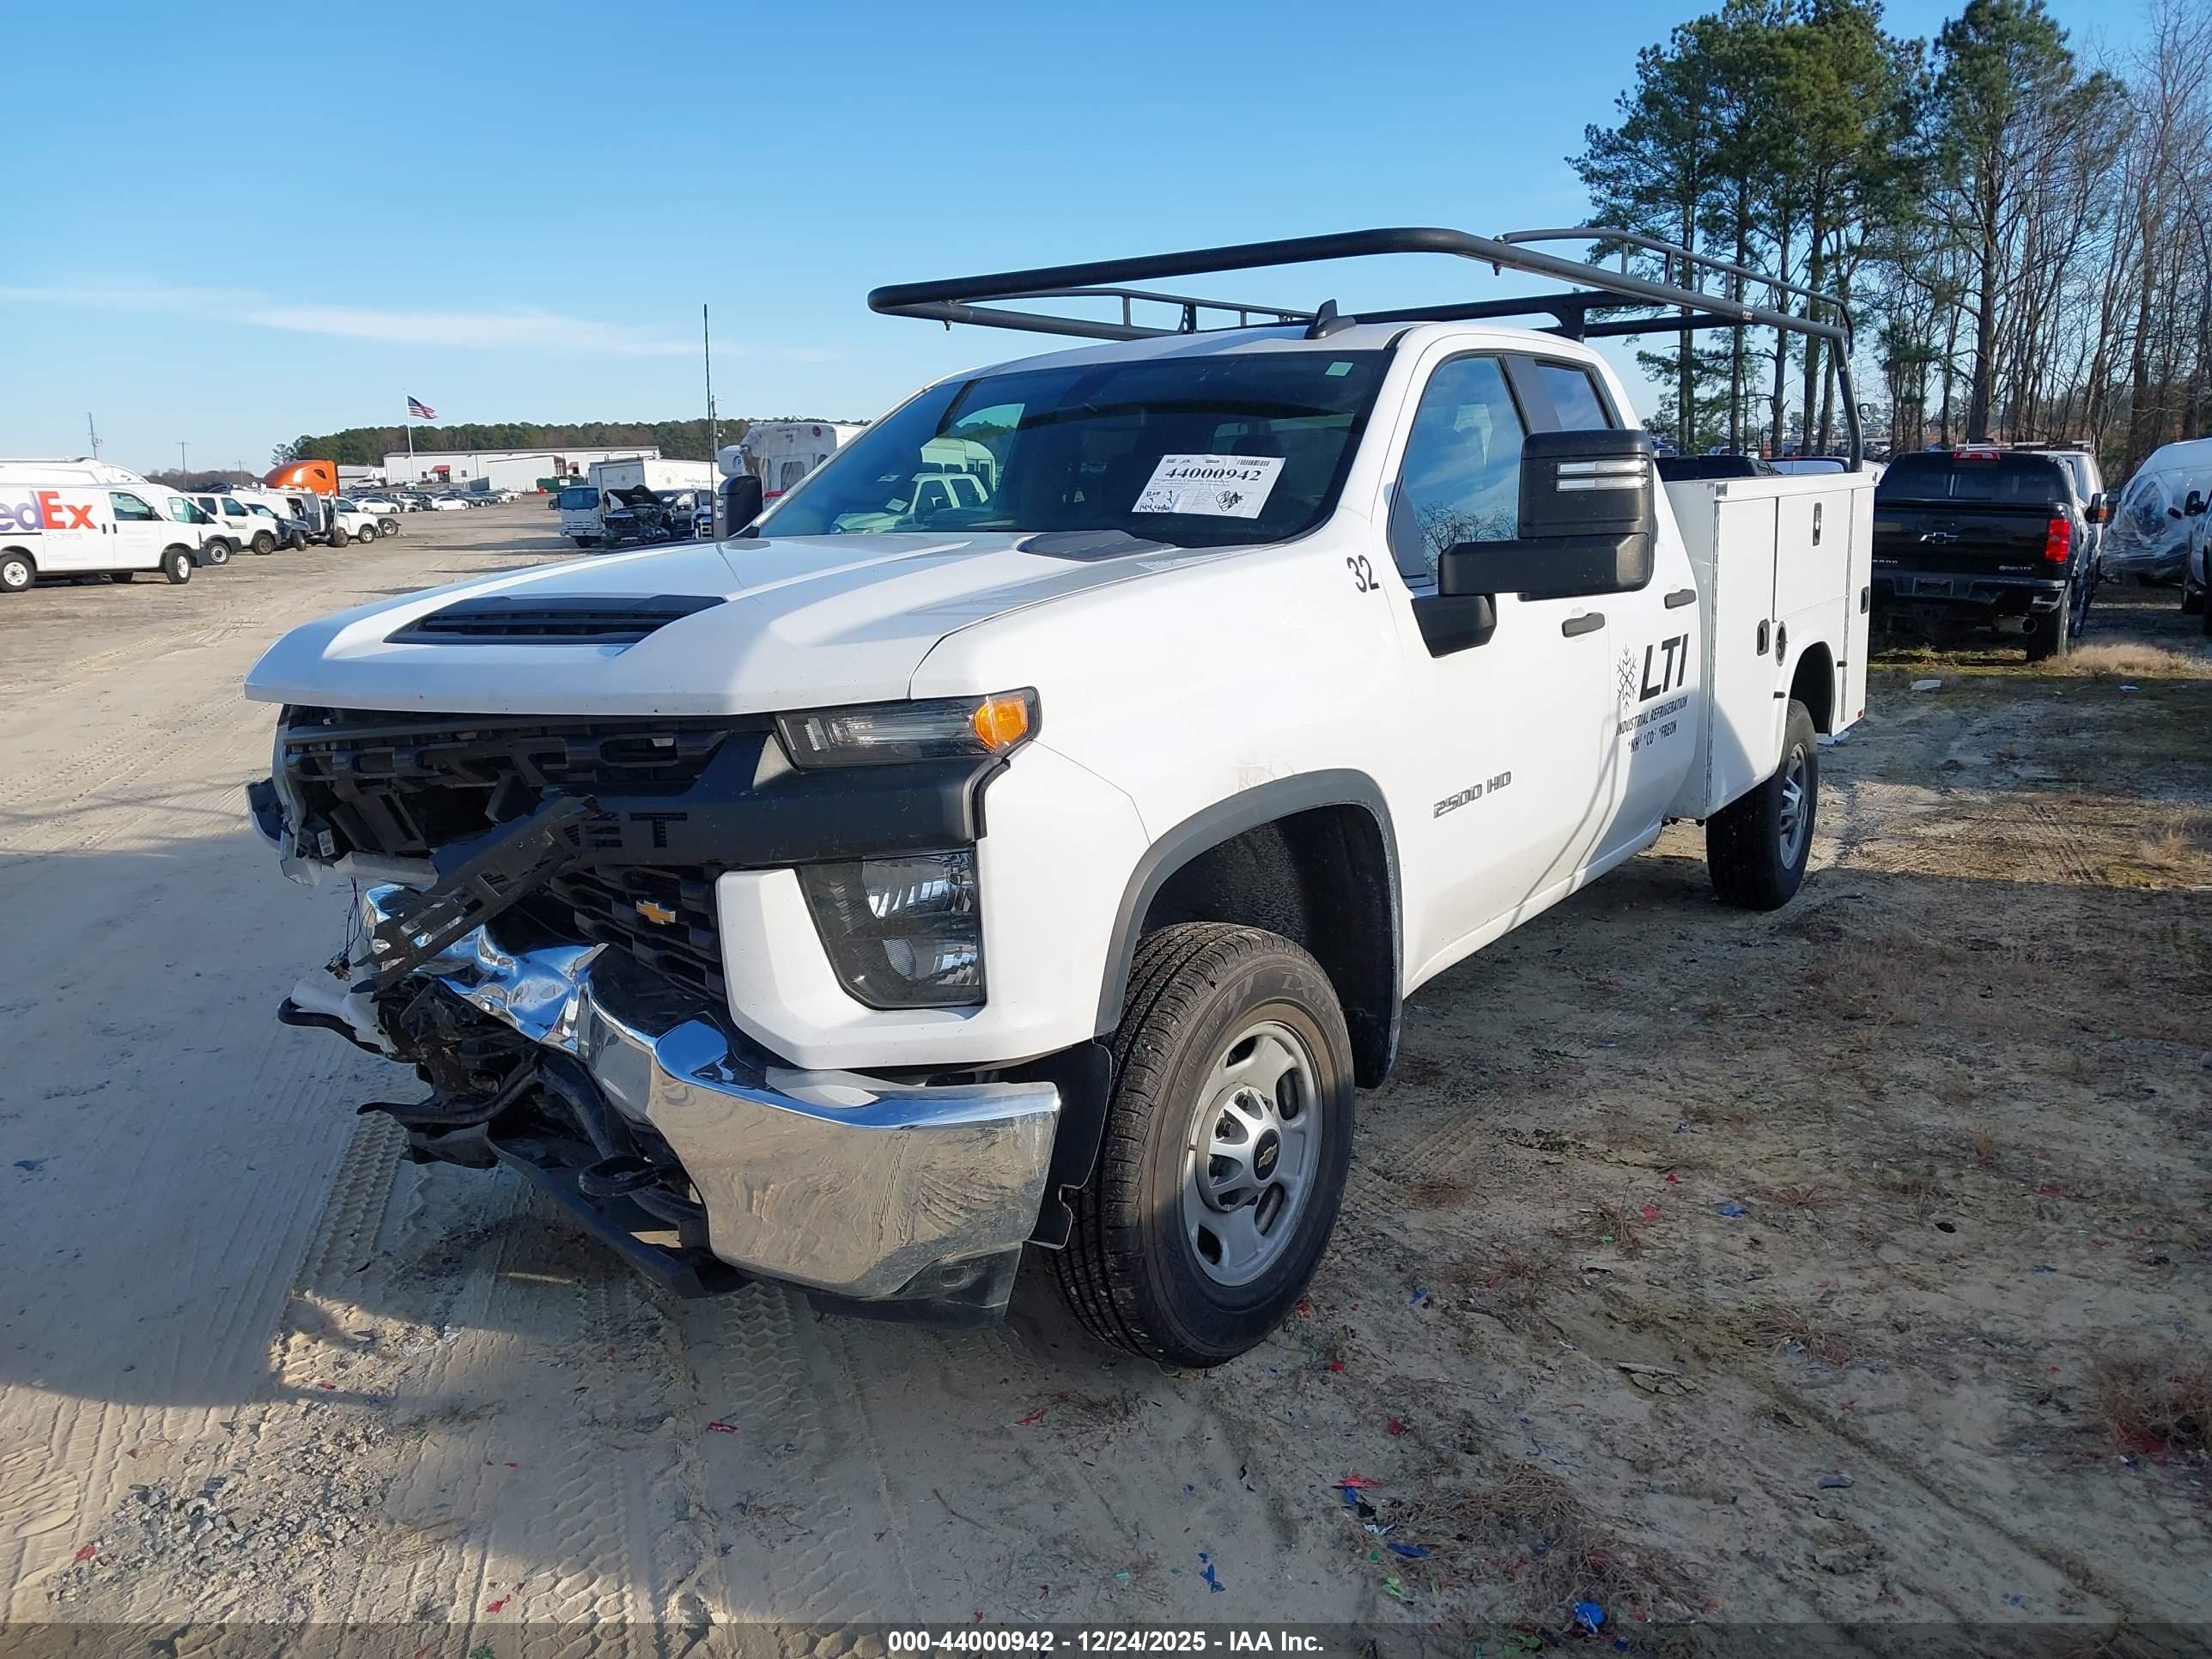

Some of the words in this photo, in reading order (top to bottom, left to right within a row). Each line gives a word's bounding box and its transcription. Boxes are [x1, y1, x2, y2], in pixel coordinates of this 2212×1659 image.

[1164, 467, 1262, 482] 44000942
[1346, 555, 1380, 592] 32
[1639, 633, 1689, 702] LTI
[1615, 710, 1650, 737] INDUSTRIAL
[1650, 695, 1689, 723] REFRIGERATION
[1433, 783, 1482, 819] 2500
[1486, 771, 1511, 794] HD
